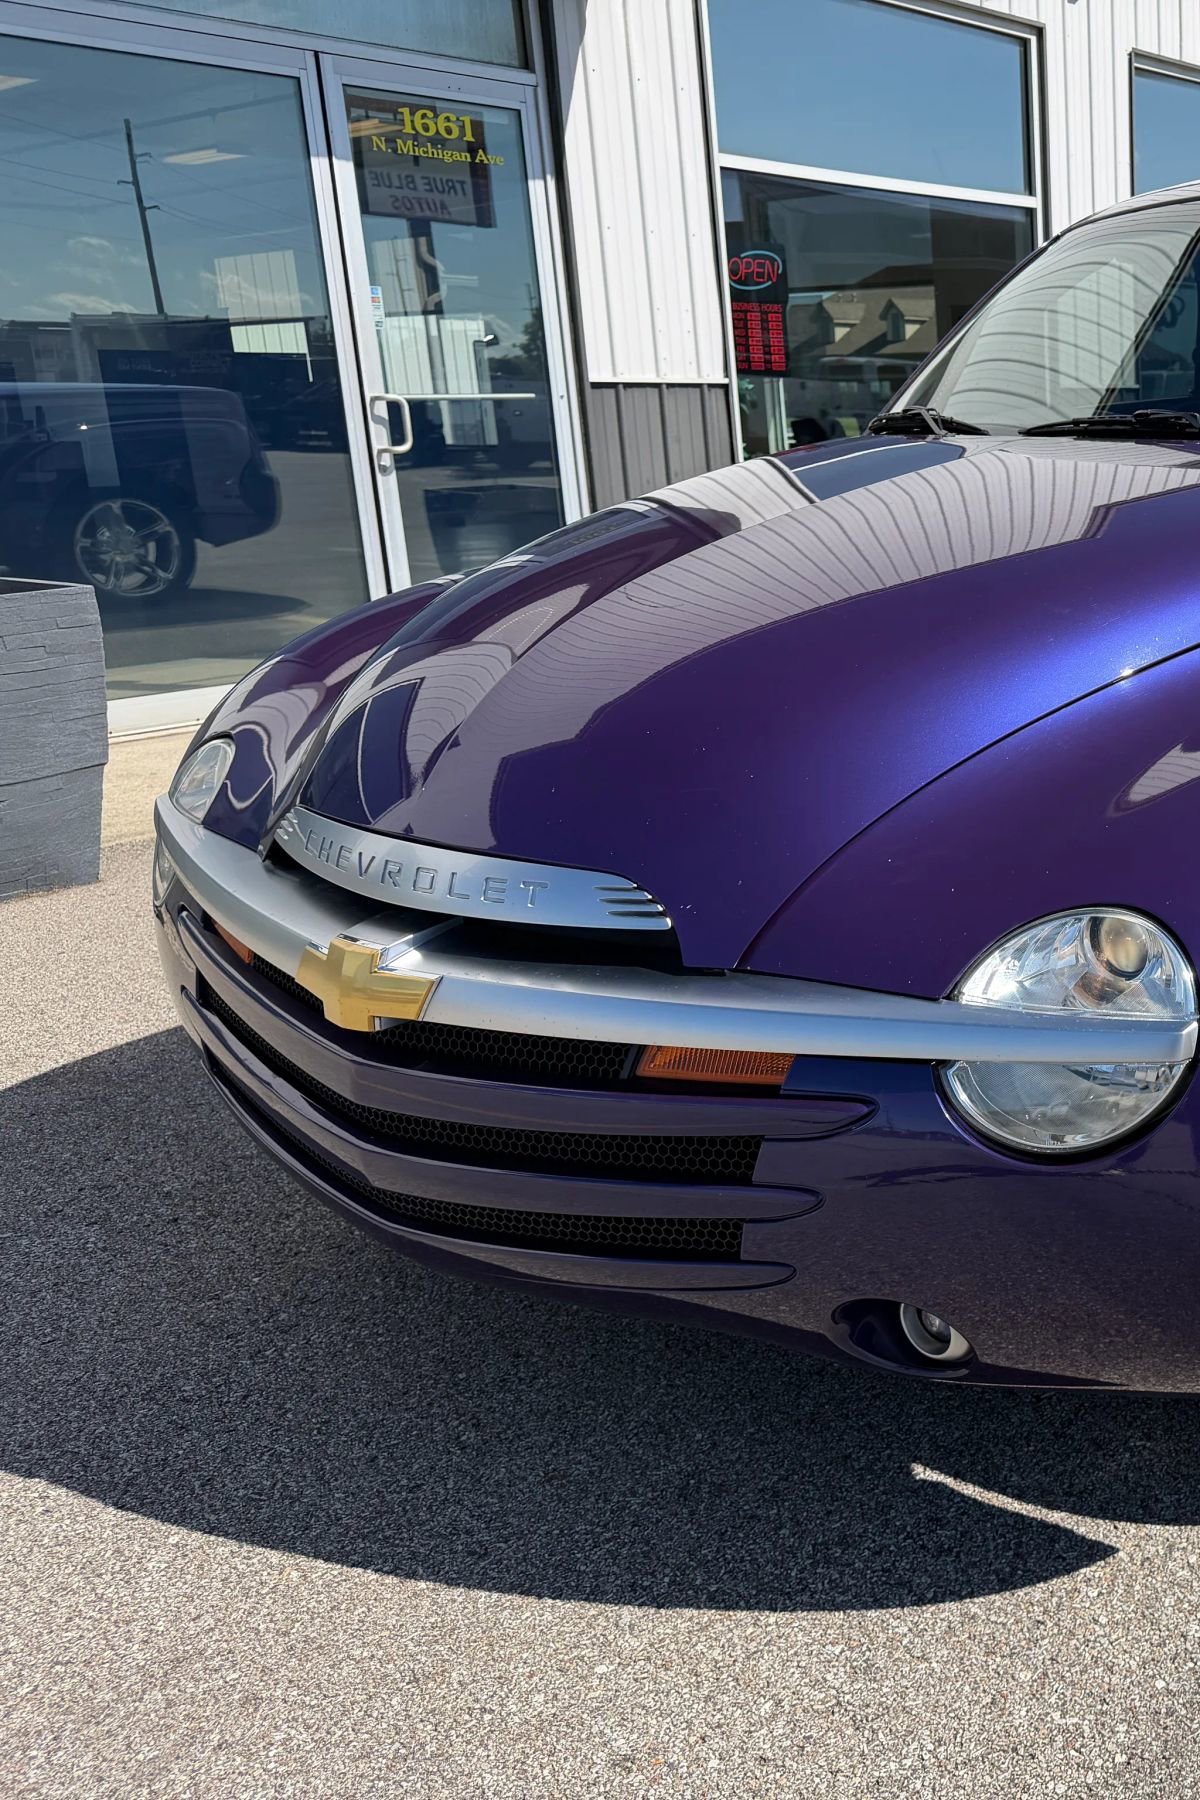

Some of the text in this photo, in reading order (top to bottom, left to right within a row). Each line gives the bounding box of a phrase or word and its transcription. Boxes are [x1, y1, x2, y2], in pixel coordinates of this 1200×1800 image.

[398, 107, 475, 142] 1661
[371, 135, 504, 165] N. Michigan Ave
[729, 257, 778, 282] OPEN
[304, 828, 549, 908] CHEVROLET
